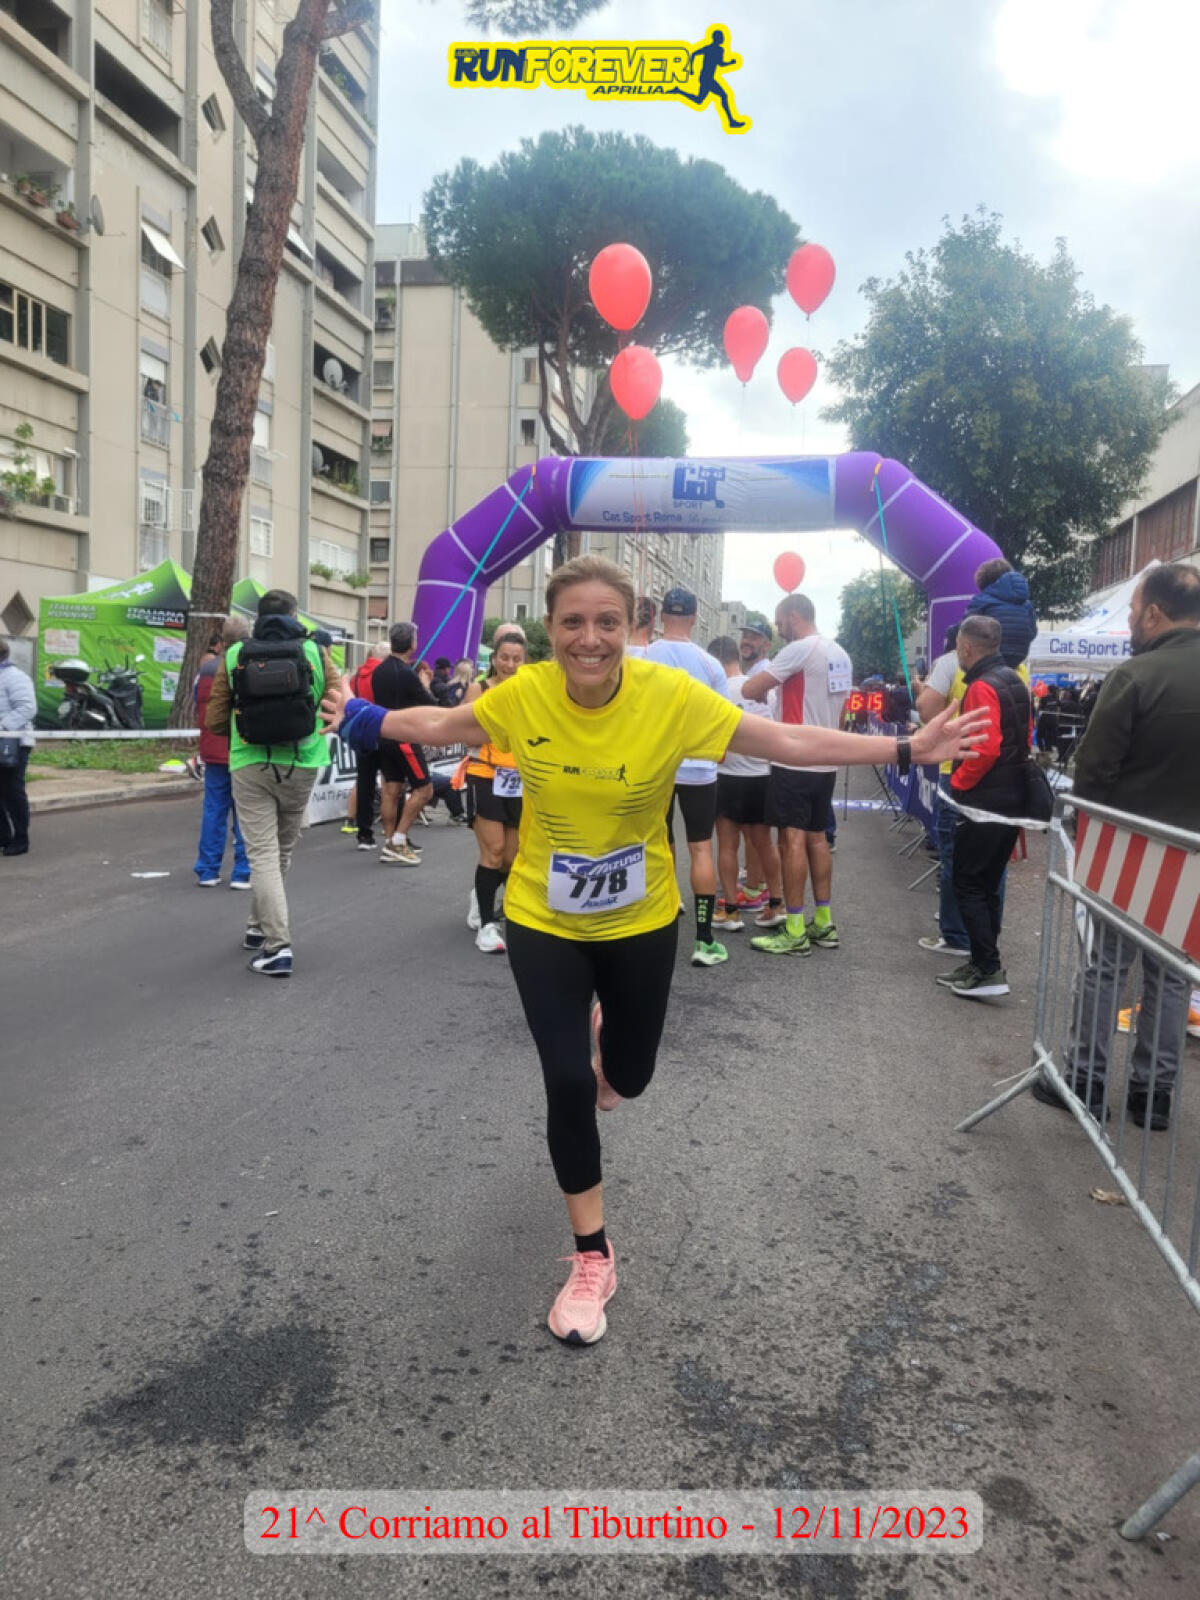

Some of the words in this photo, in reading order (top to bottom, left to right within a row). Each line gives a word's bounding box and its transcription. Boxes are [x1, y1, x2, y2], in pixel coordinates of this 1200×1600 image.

[602, 510, 621, 522] Cat
[126, 607, 185, 618] ITALIANA
[1050, 638, 1074, 654] Cat
[1077, 639, 1119, 658] Sport
[569, 868, 627, 898] 778
